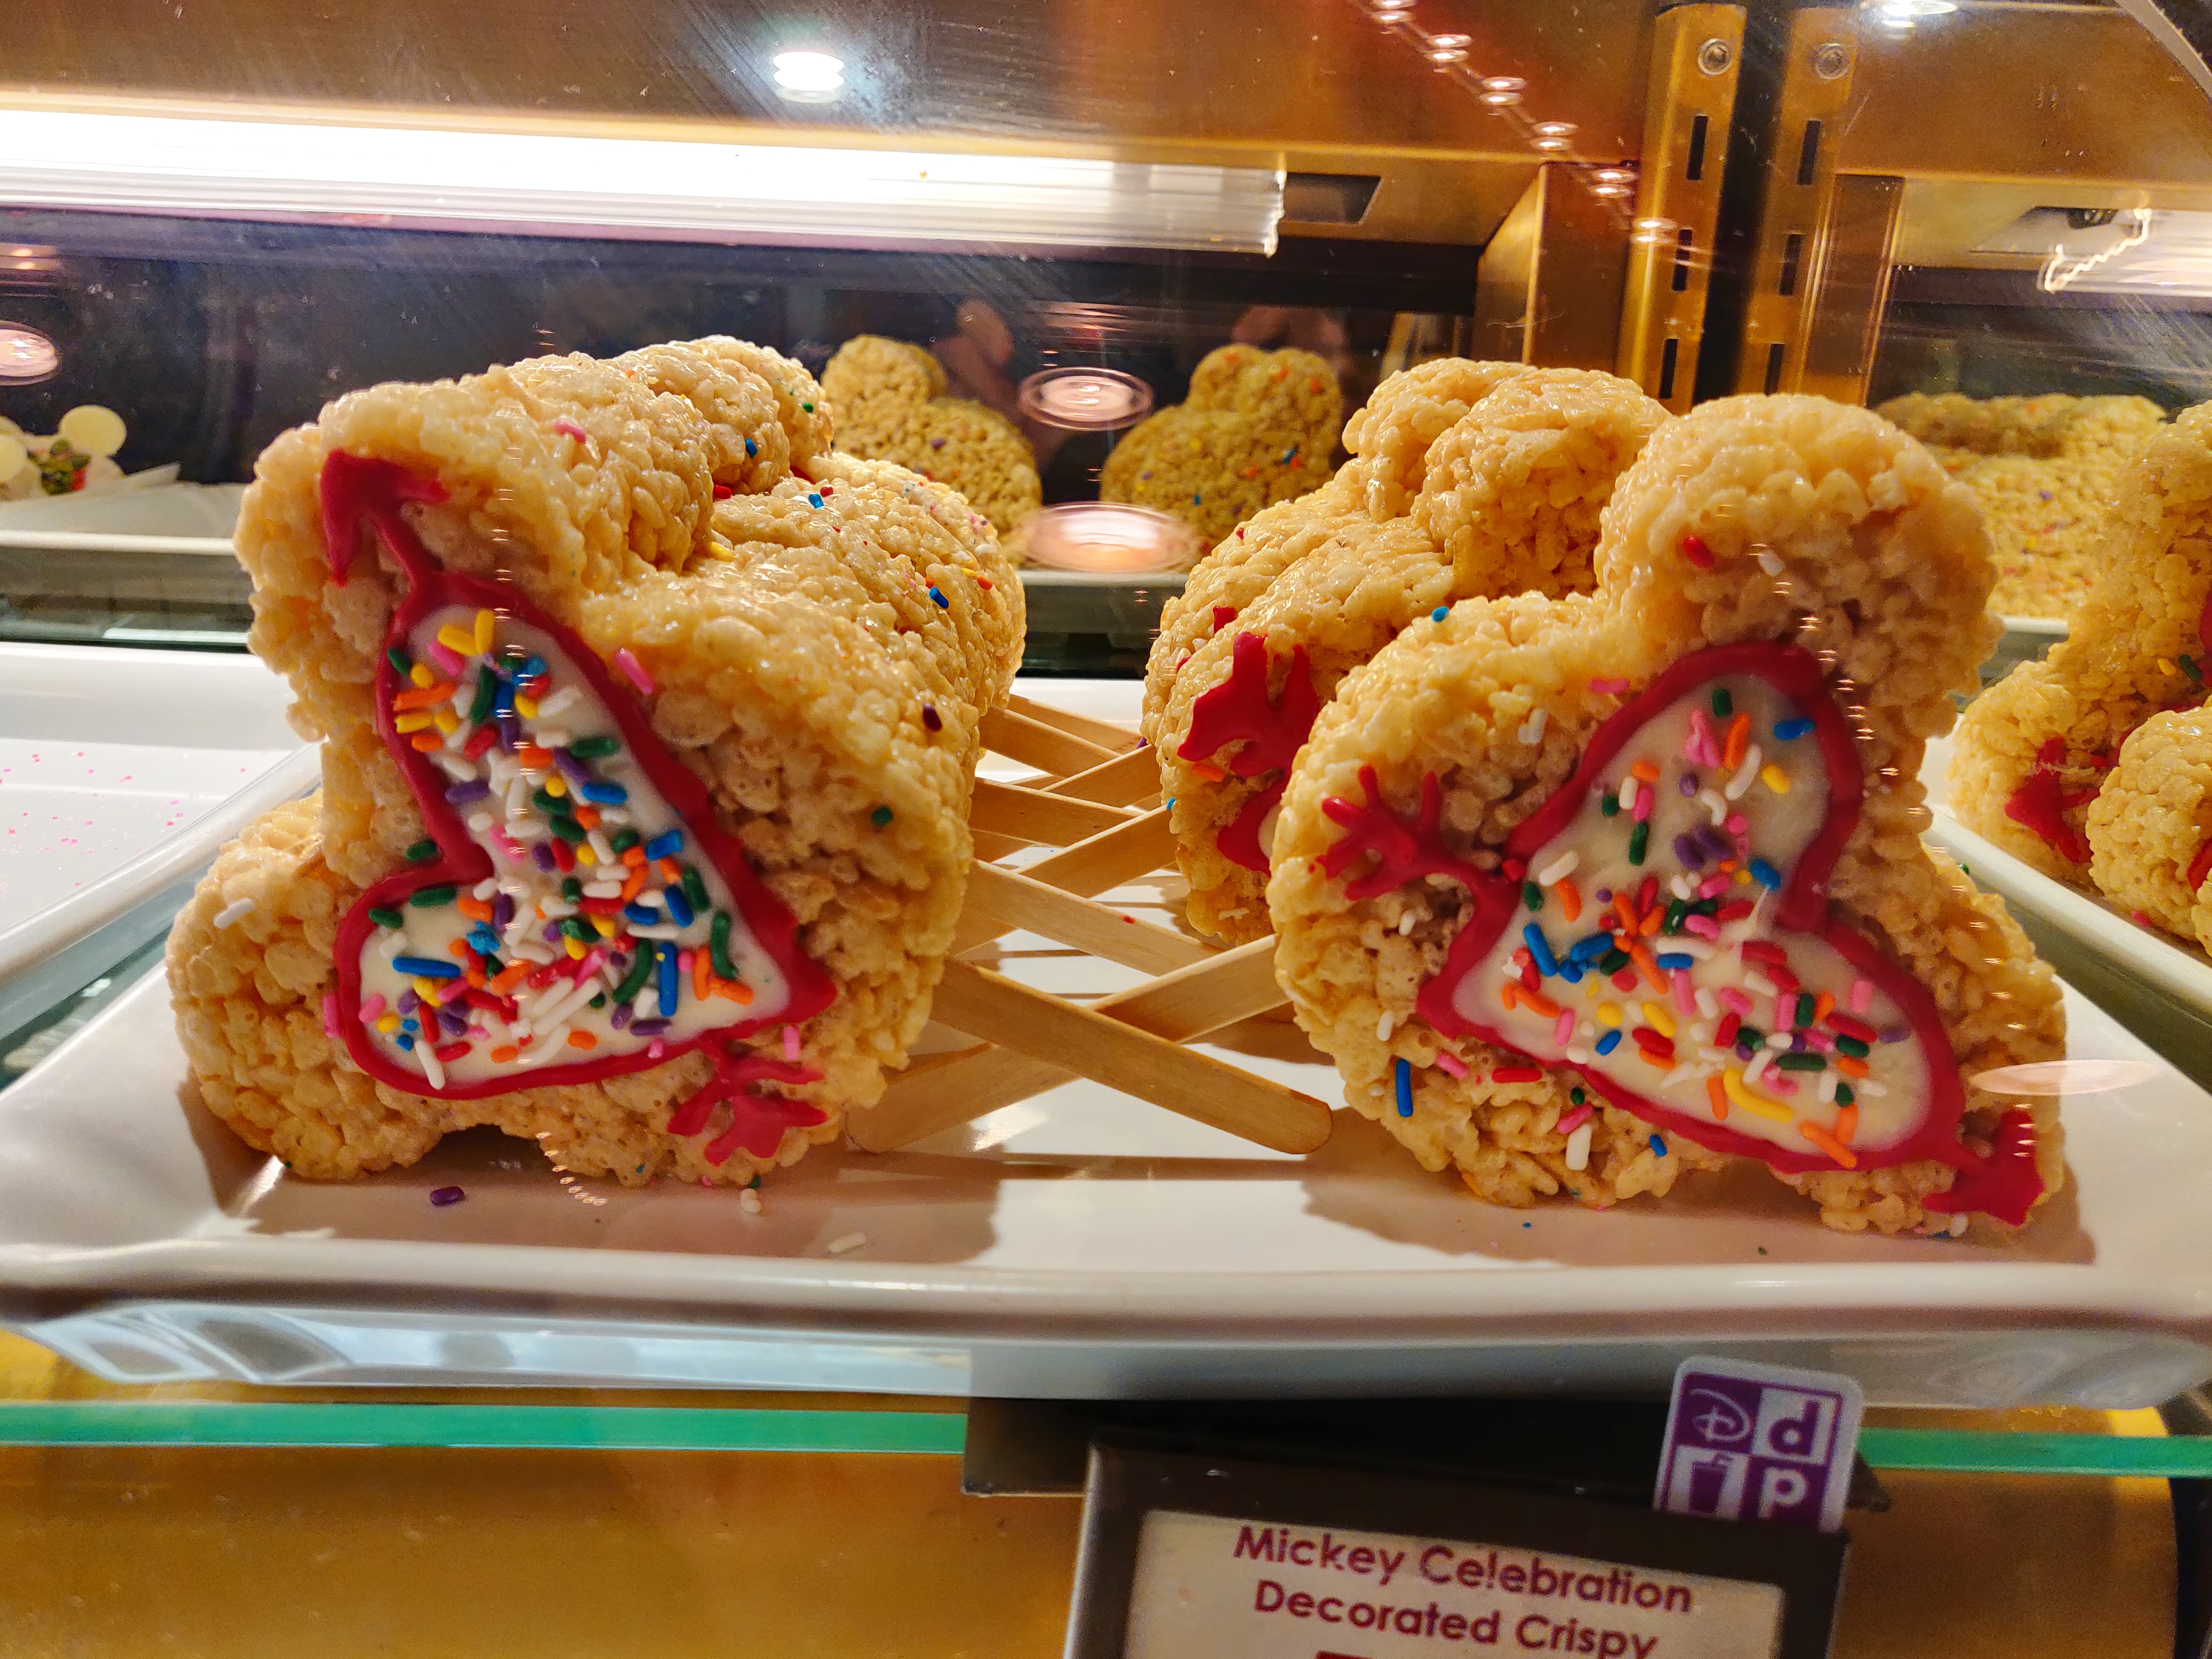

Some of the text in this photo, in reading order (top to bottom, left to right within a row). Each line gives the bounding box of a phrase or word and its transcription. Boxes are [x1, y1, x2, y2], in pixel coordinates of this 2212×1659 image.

[1768, 1400, 1820, 1456] d
[1233, 1526, 1692, 1612] Mickey Celebration
[1254, 1579, 1659, 1659] Decorated Crispy
